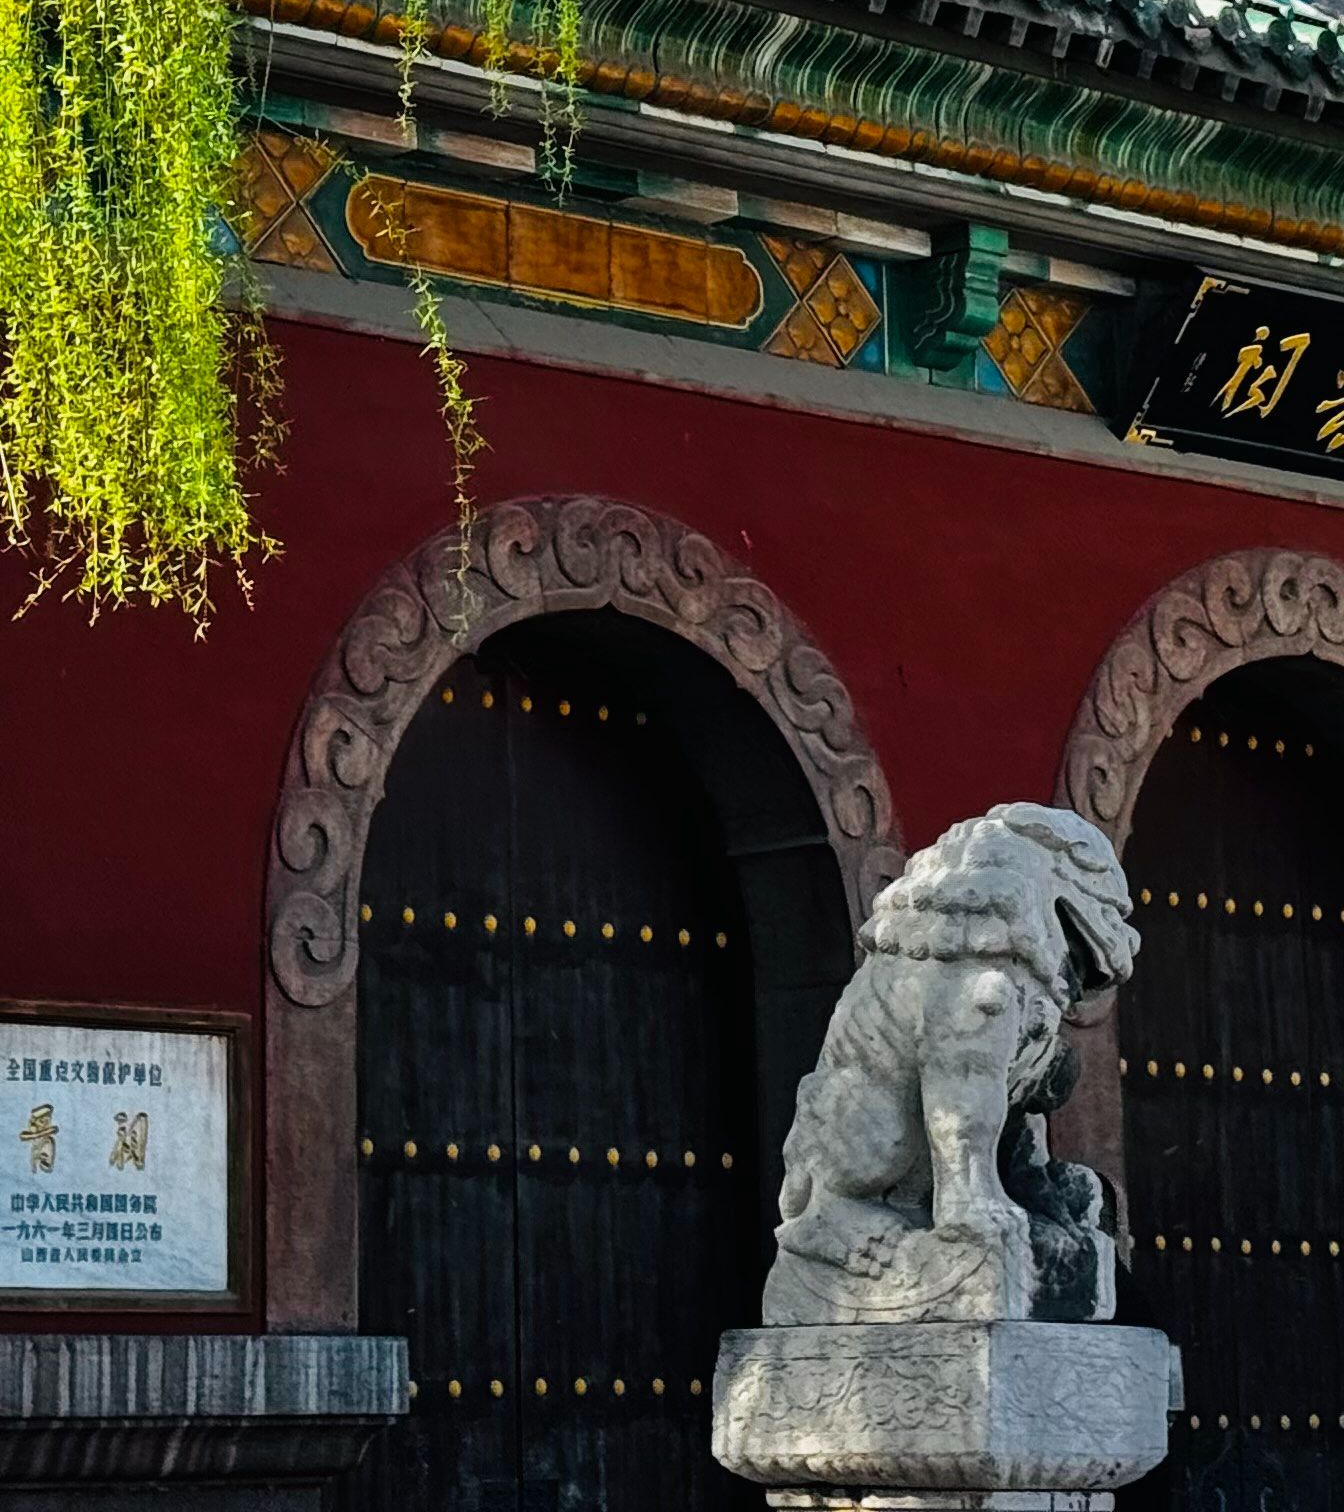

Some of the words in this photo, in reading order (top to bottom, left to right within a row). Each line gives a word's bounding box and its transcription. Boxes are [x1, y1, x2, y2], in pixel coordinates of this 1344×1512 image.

[6, 1058, 162, 1086] 全国重点文物保护单位
[11, 1193, 157, 1214] 中华人民共和国国务院
[2, 1220, 162, 1241] 一九六一年三月四日公布
